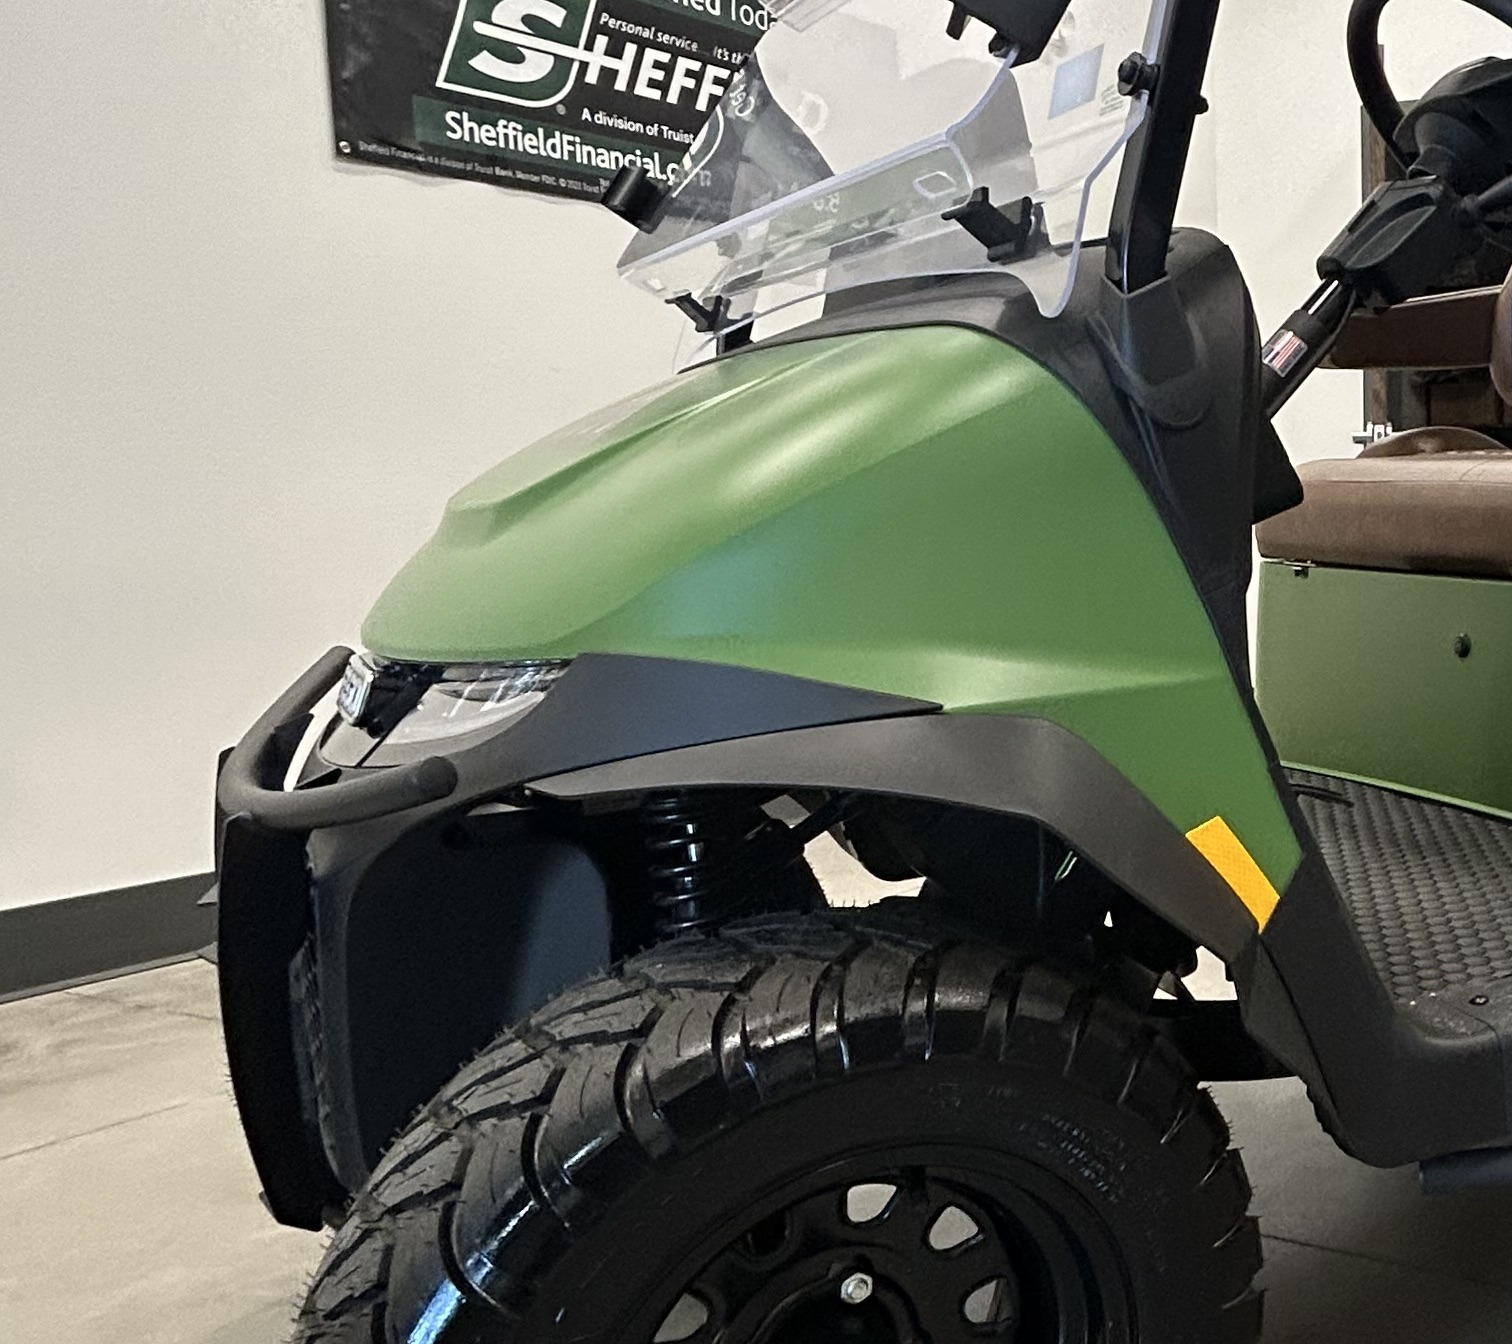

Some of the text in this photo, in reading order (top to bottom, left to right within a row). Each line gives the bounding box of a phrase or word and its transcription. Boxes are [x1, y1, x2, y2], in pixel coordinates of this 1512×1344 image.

[600, 12, 655, 40] Personal
[581, 108, 593, 123] A
[594, 111, 645, 134] division
[646, 125, 660, 137] of
